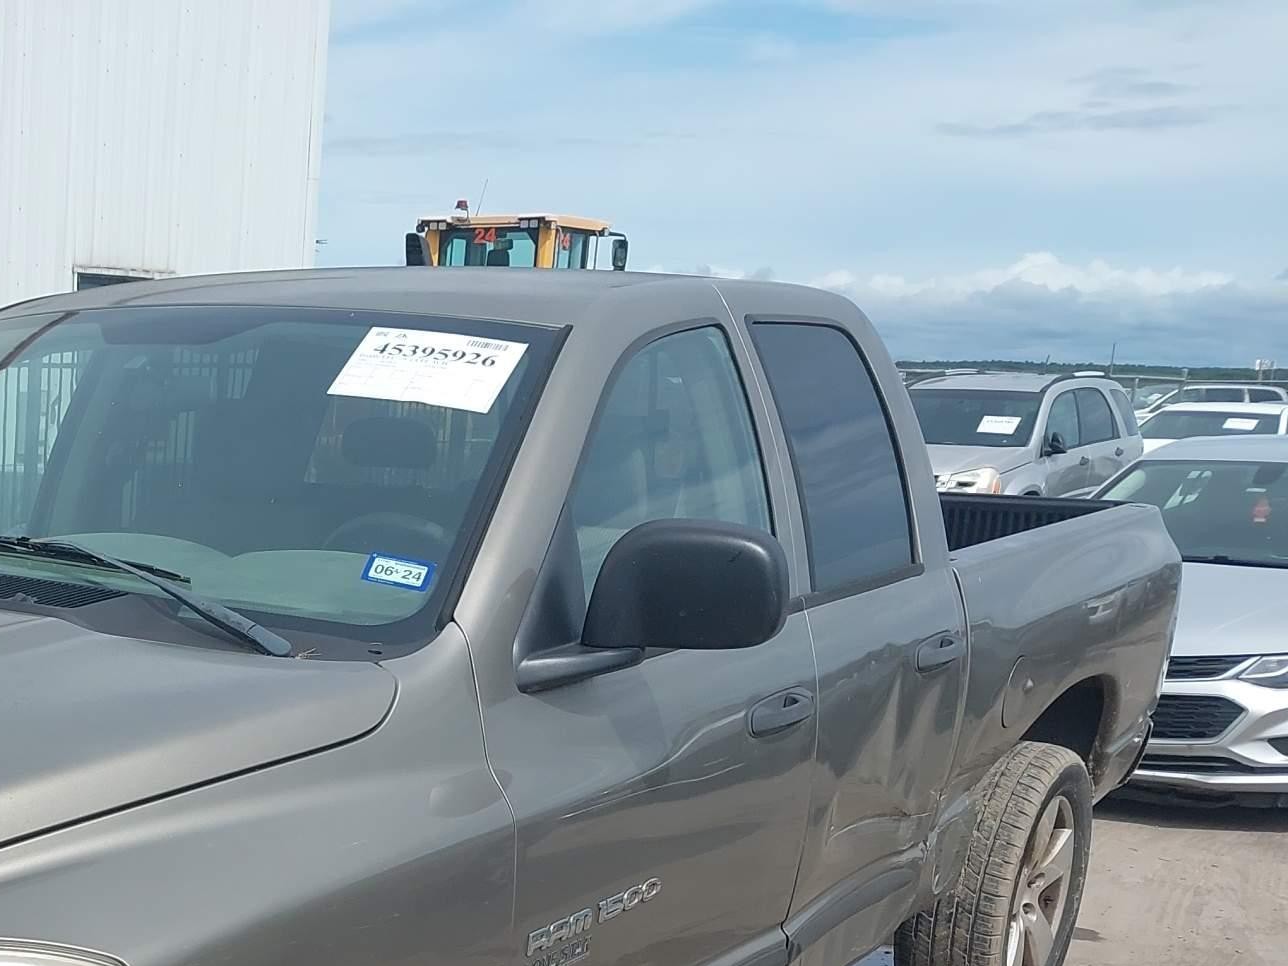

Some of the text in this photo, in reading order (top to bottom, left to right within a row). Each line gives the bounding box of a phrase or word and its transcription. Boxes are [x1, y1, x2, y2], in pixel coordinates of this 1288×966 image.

[474, 227, 496, 243] 24
[373, 342, 498, 368] 45395926
[597, 877, 662, 924] 1500
